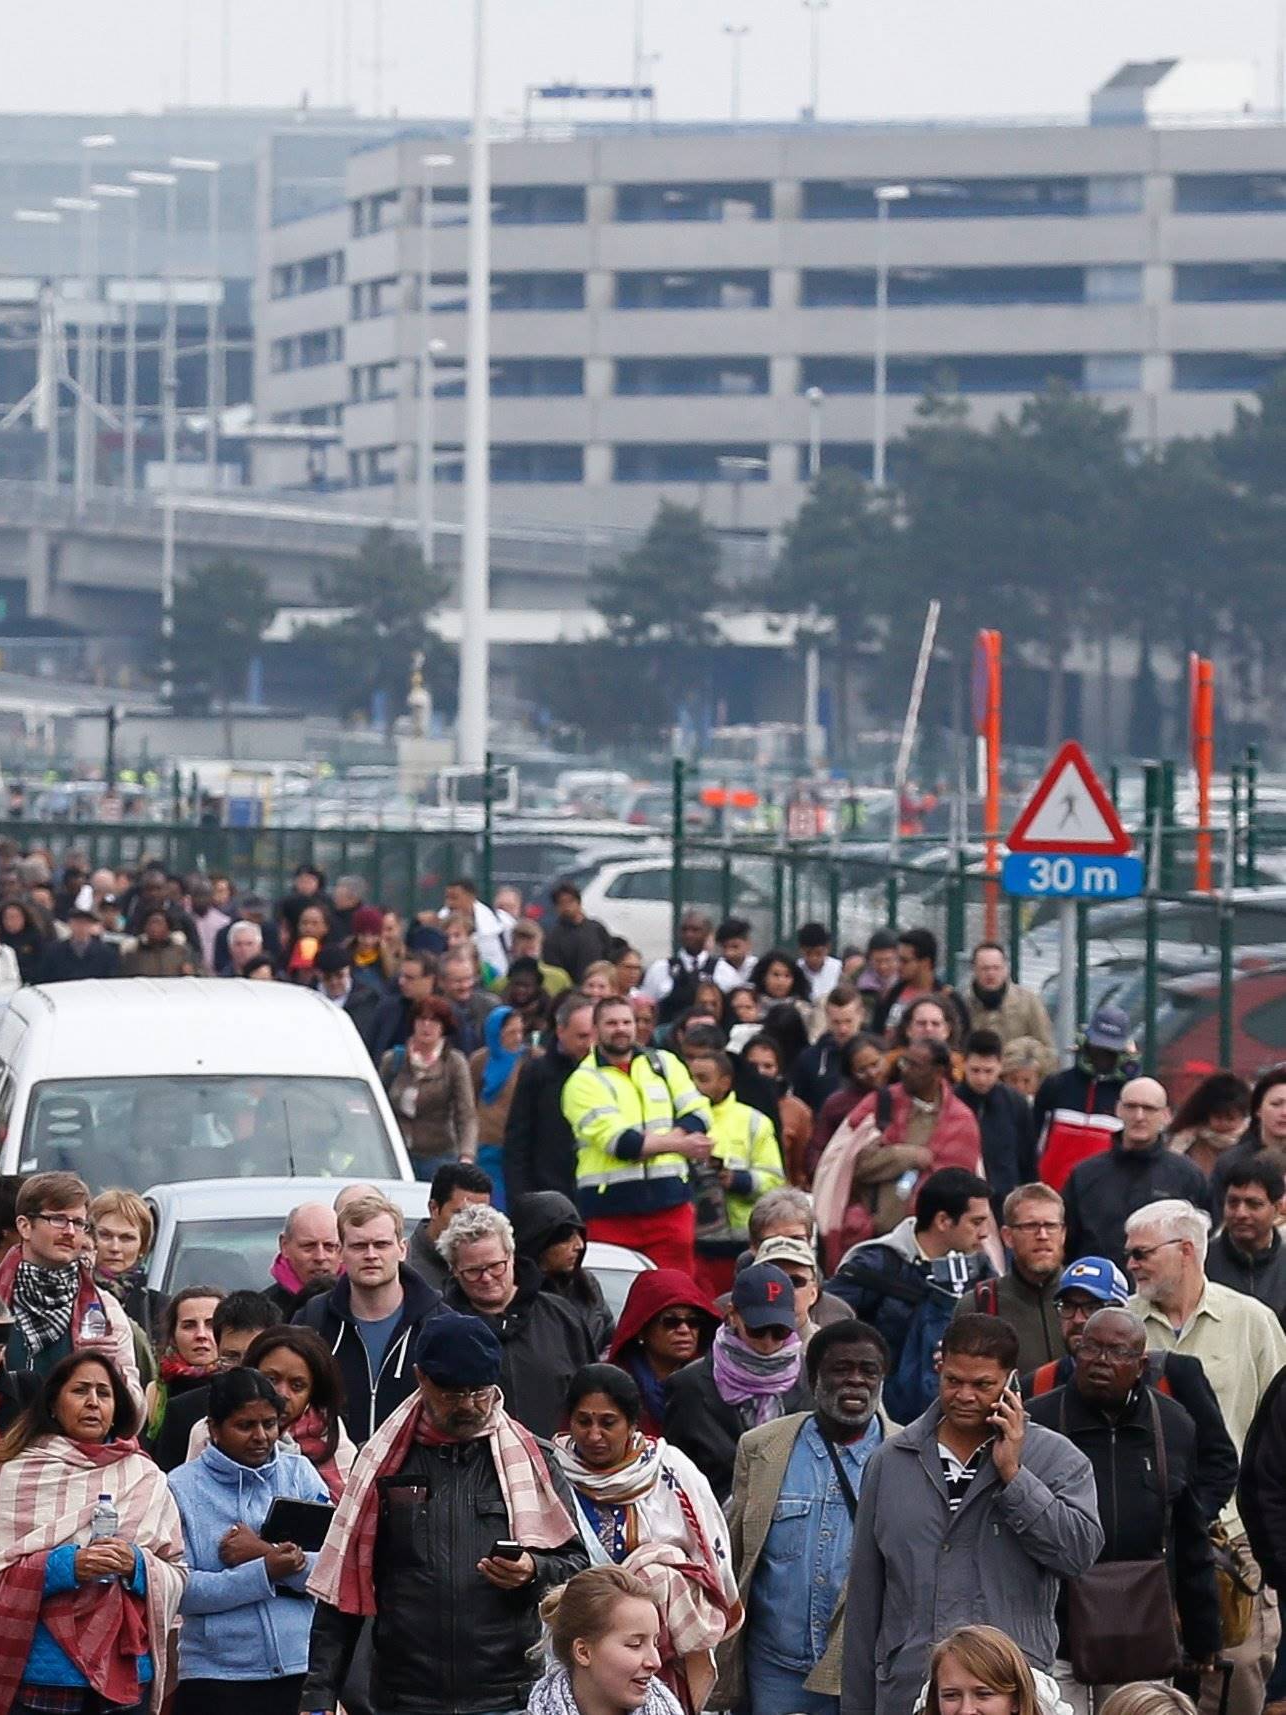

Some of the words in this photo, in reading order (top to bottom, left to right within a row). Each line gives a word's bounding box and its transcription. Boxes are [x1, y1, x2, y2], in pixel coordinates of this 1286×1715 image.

[1029, 857, 1075, 892] 30
[1082, 866, 1118, 892] m
[766, 1281, 783, 1302] P
